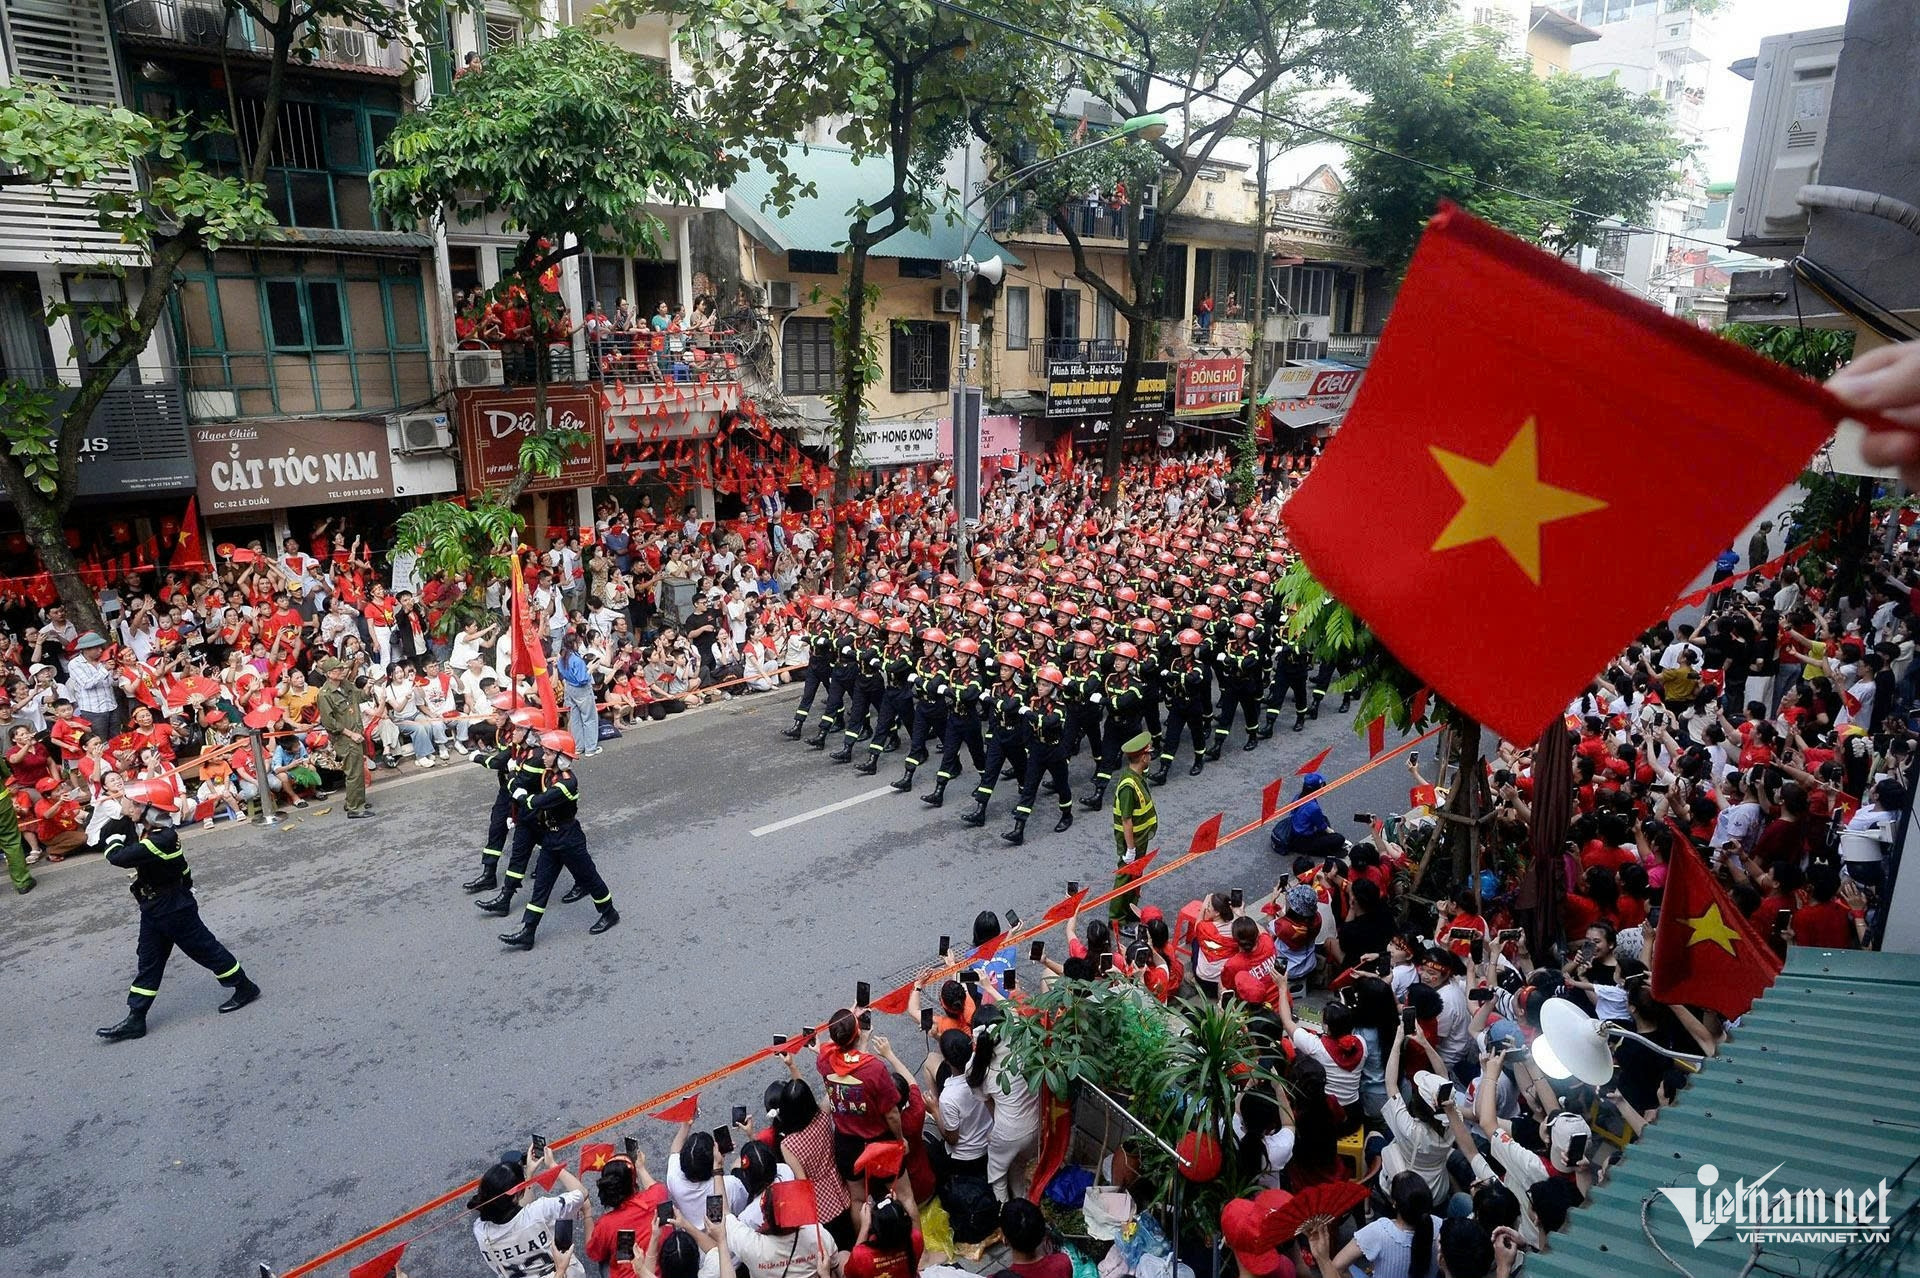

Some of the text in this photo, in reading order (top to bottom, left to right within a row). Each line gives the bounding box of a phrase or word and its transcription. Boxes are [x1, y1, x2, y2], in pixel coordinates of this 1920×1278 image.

[1052, 365, 1069, 375] Minh
[1090, 364, 1103, 374] Hair
[1104, 364, 1110, 374] &
[1110, 364, 1122, 376] Spa
[1191, 364, 1236, 384] ĐỒNG HỒ
[1317, 373, 1354, 393] deli
[546, 406, 586, 431] Liên
[229, 426, 257, 438] Chiến
[882, 430, 907, 443] HONG
[909, 426, 932, 441] KONG
[210, 443, 380, 492] CẮT TÓC NAM
